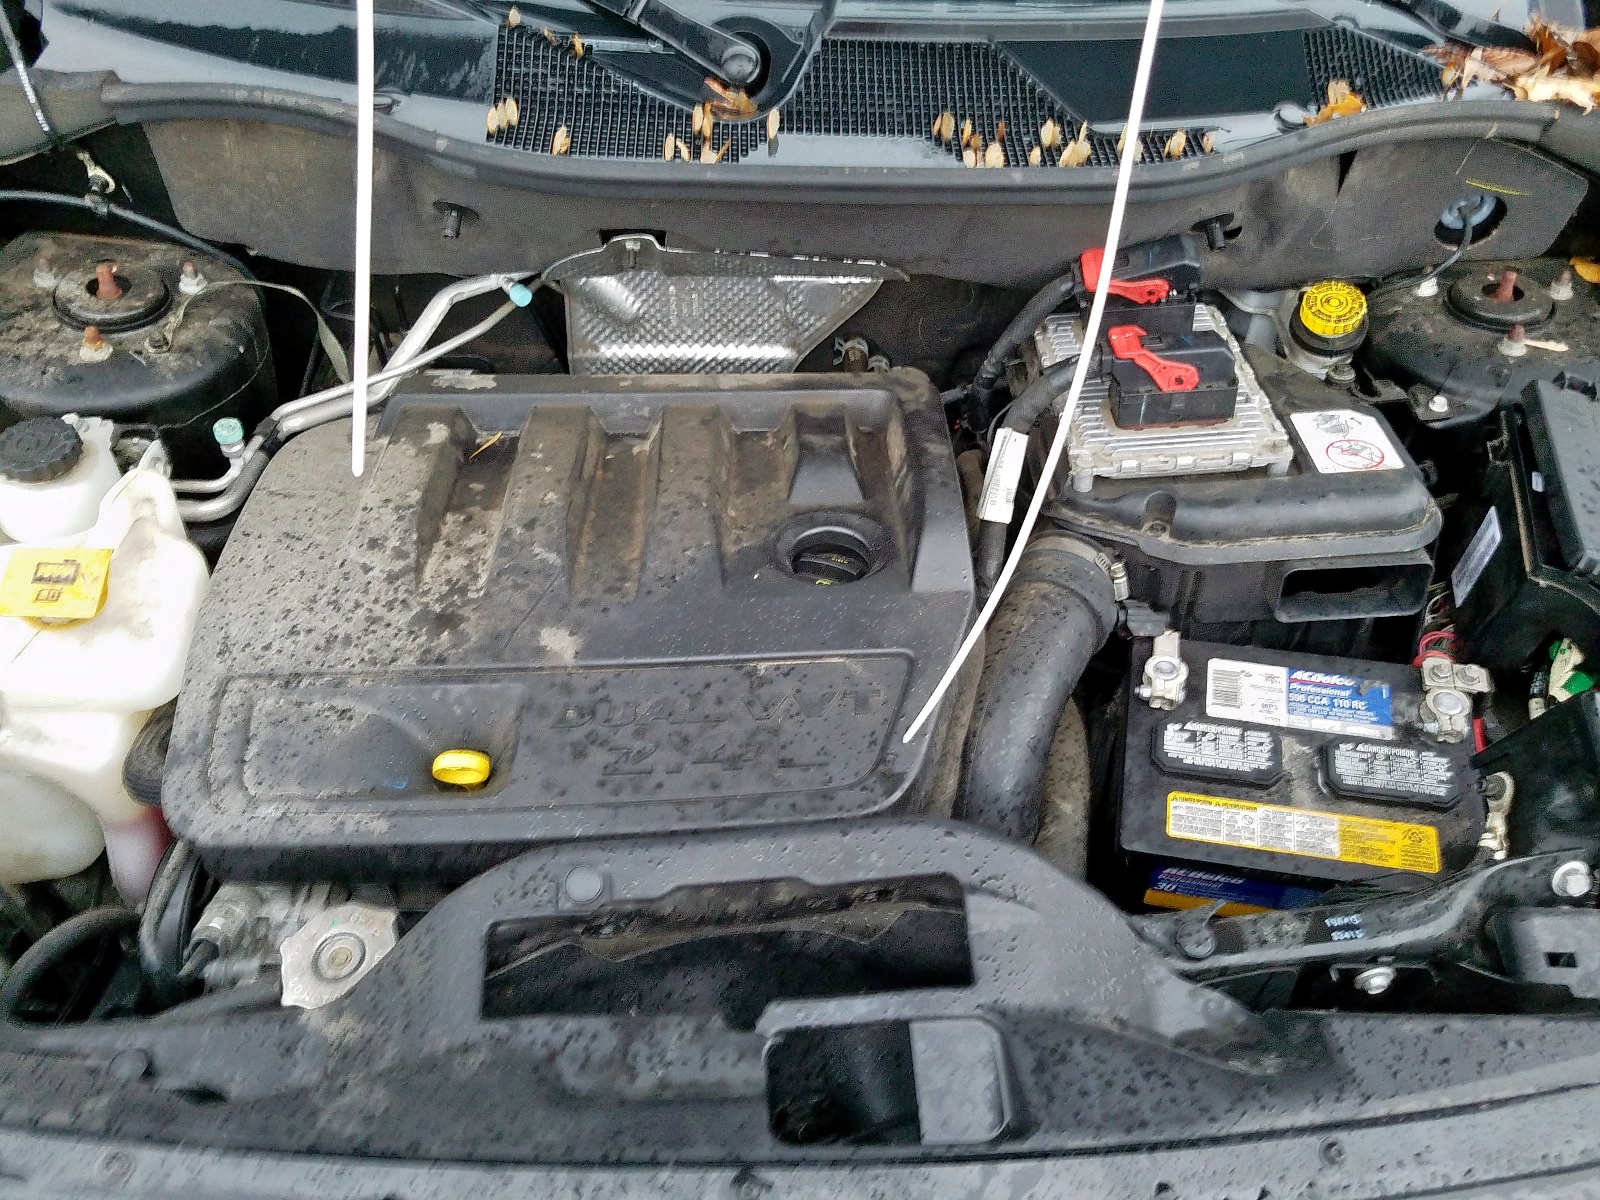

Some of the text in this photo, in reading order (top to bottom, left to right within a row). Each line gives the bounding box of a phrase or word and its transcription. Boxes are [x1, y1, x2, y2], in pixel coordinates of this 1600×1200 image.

[1289, 670, 1355, 687] ACDelco
[1290, 682, 1352, 697] Professional
[1289, 692, 1367, 711] 590 CCA 110 RC
